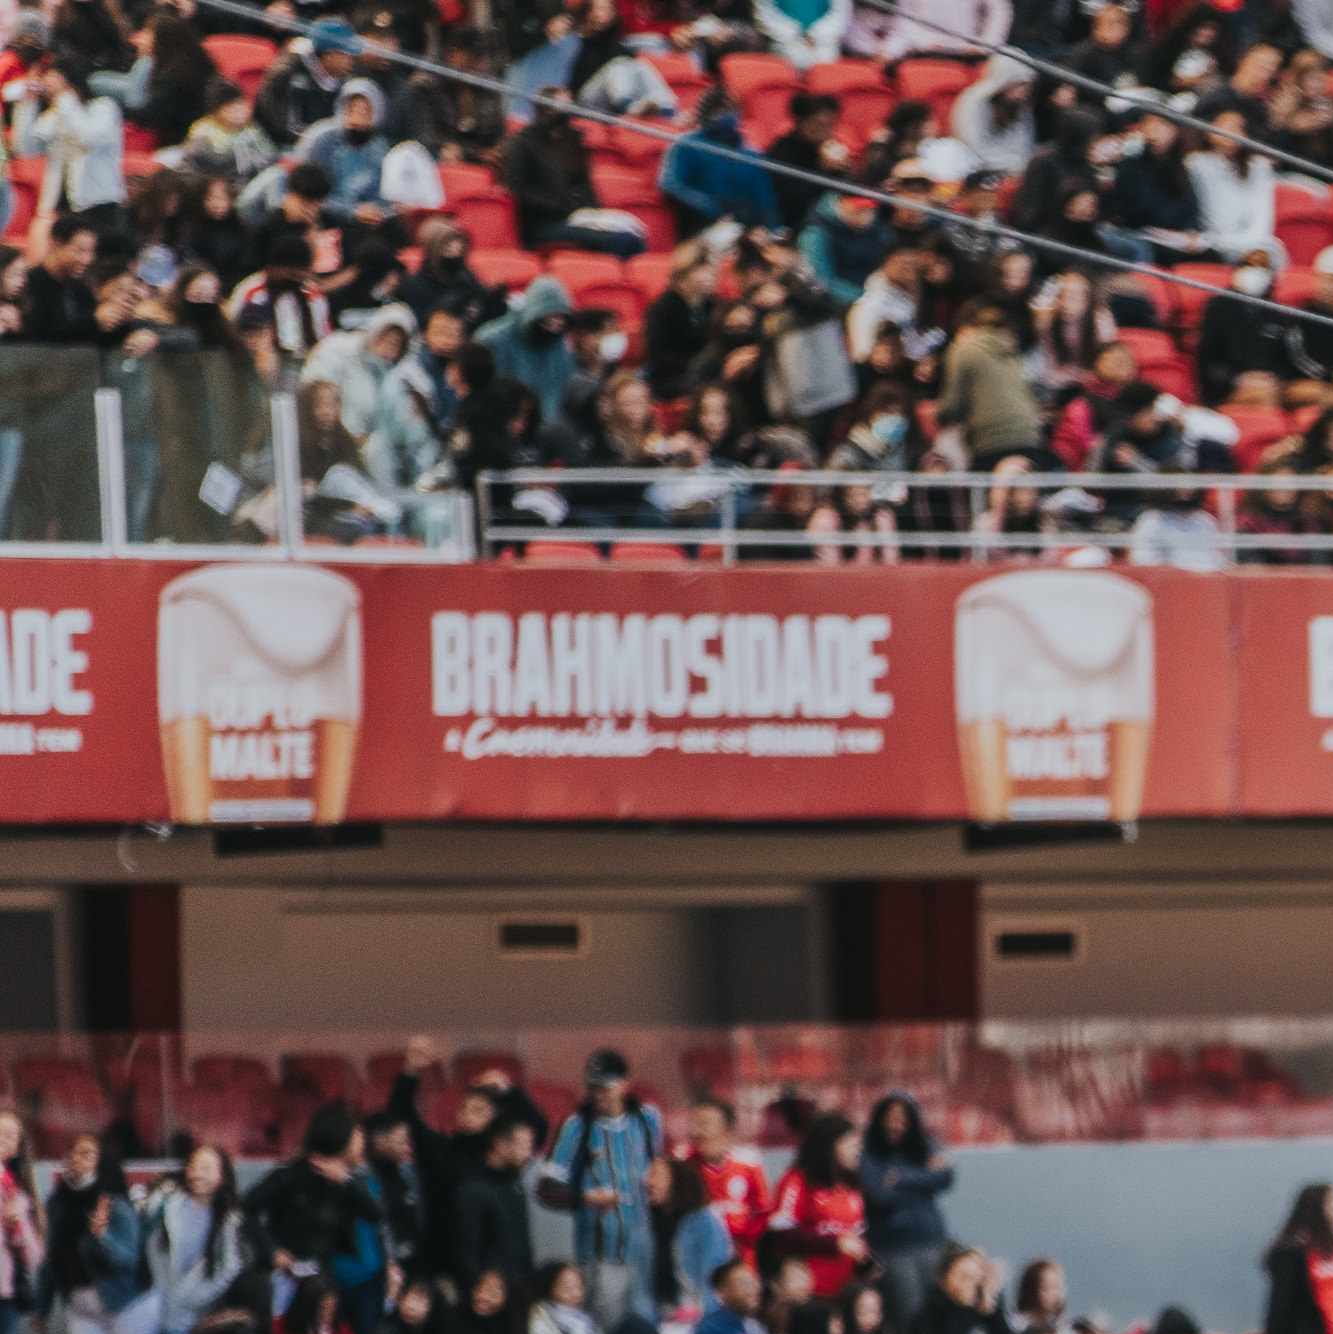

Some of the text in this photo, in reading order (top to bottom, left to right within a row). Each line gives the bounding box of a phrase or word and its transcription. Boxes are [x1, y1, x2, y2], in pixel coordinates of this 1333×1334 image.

[0, 608, 93, 715] DE
[431, 611, 893, 717] BRAHMOSIDADE
[209, 732, 315, 780] MALTE
